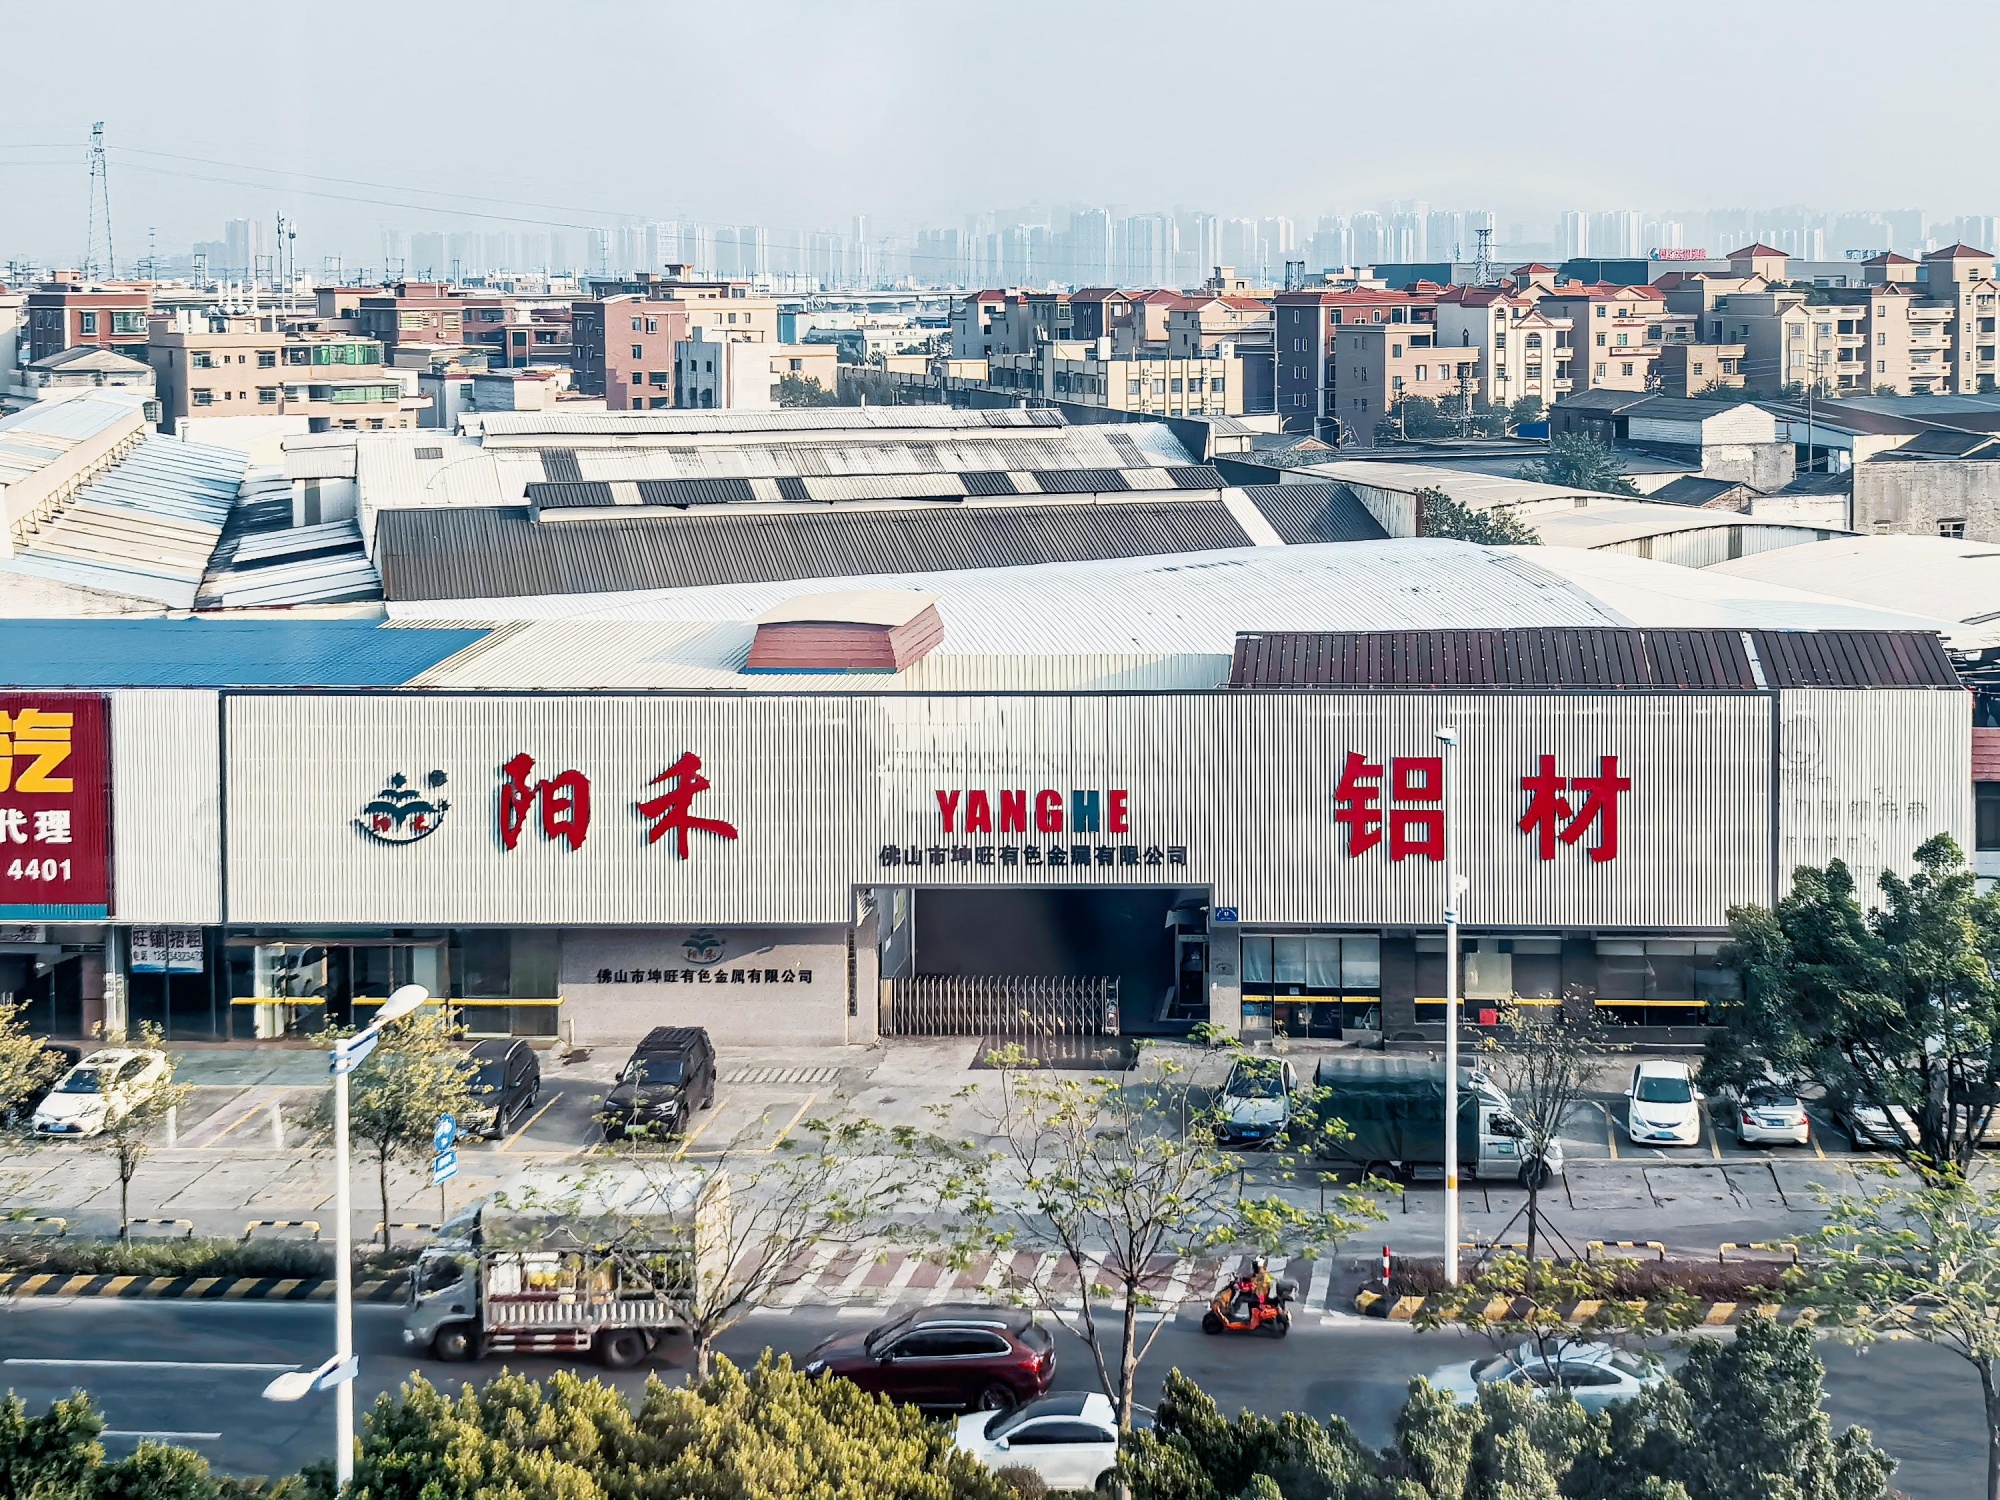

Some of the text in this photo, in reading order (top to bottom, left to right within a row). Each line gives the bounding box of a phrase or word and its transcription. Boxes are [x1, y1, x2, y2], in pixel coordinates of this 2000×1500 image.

[501, 752, 738, 859] 阳禾
[937, 789, 1129, 833] YANGHE
[1334, 752, 1631, 862] 铝材
[0, 808, 72, 844] 代理
[7, 858, 72, 881] 4401
[879, 845, 1188, 866] 佛山市坤旺有色金属有限公司
[596, 968, 814, 984] 佛山市坤旺有色金属有限公司
